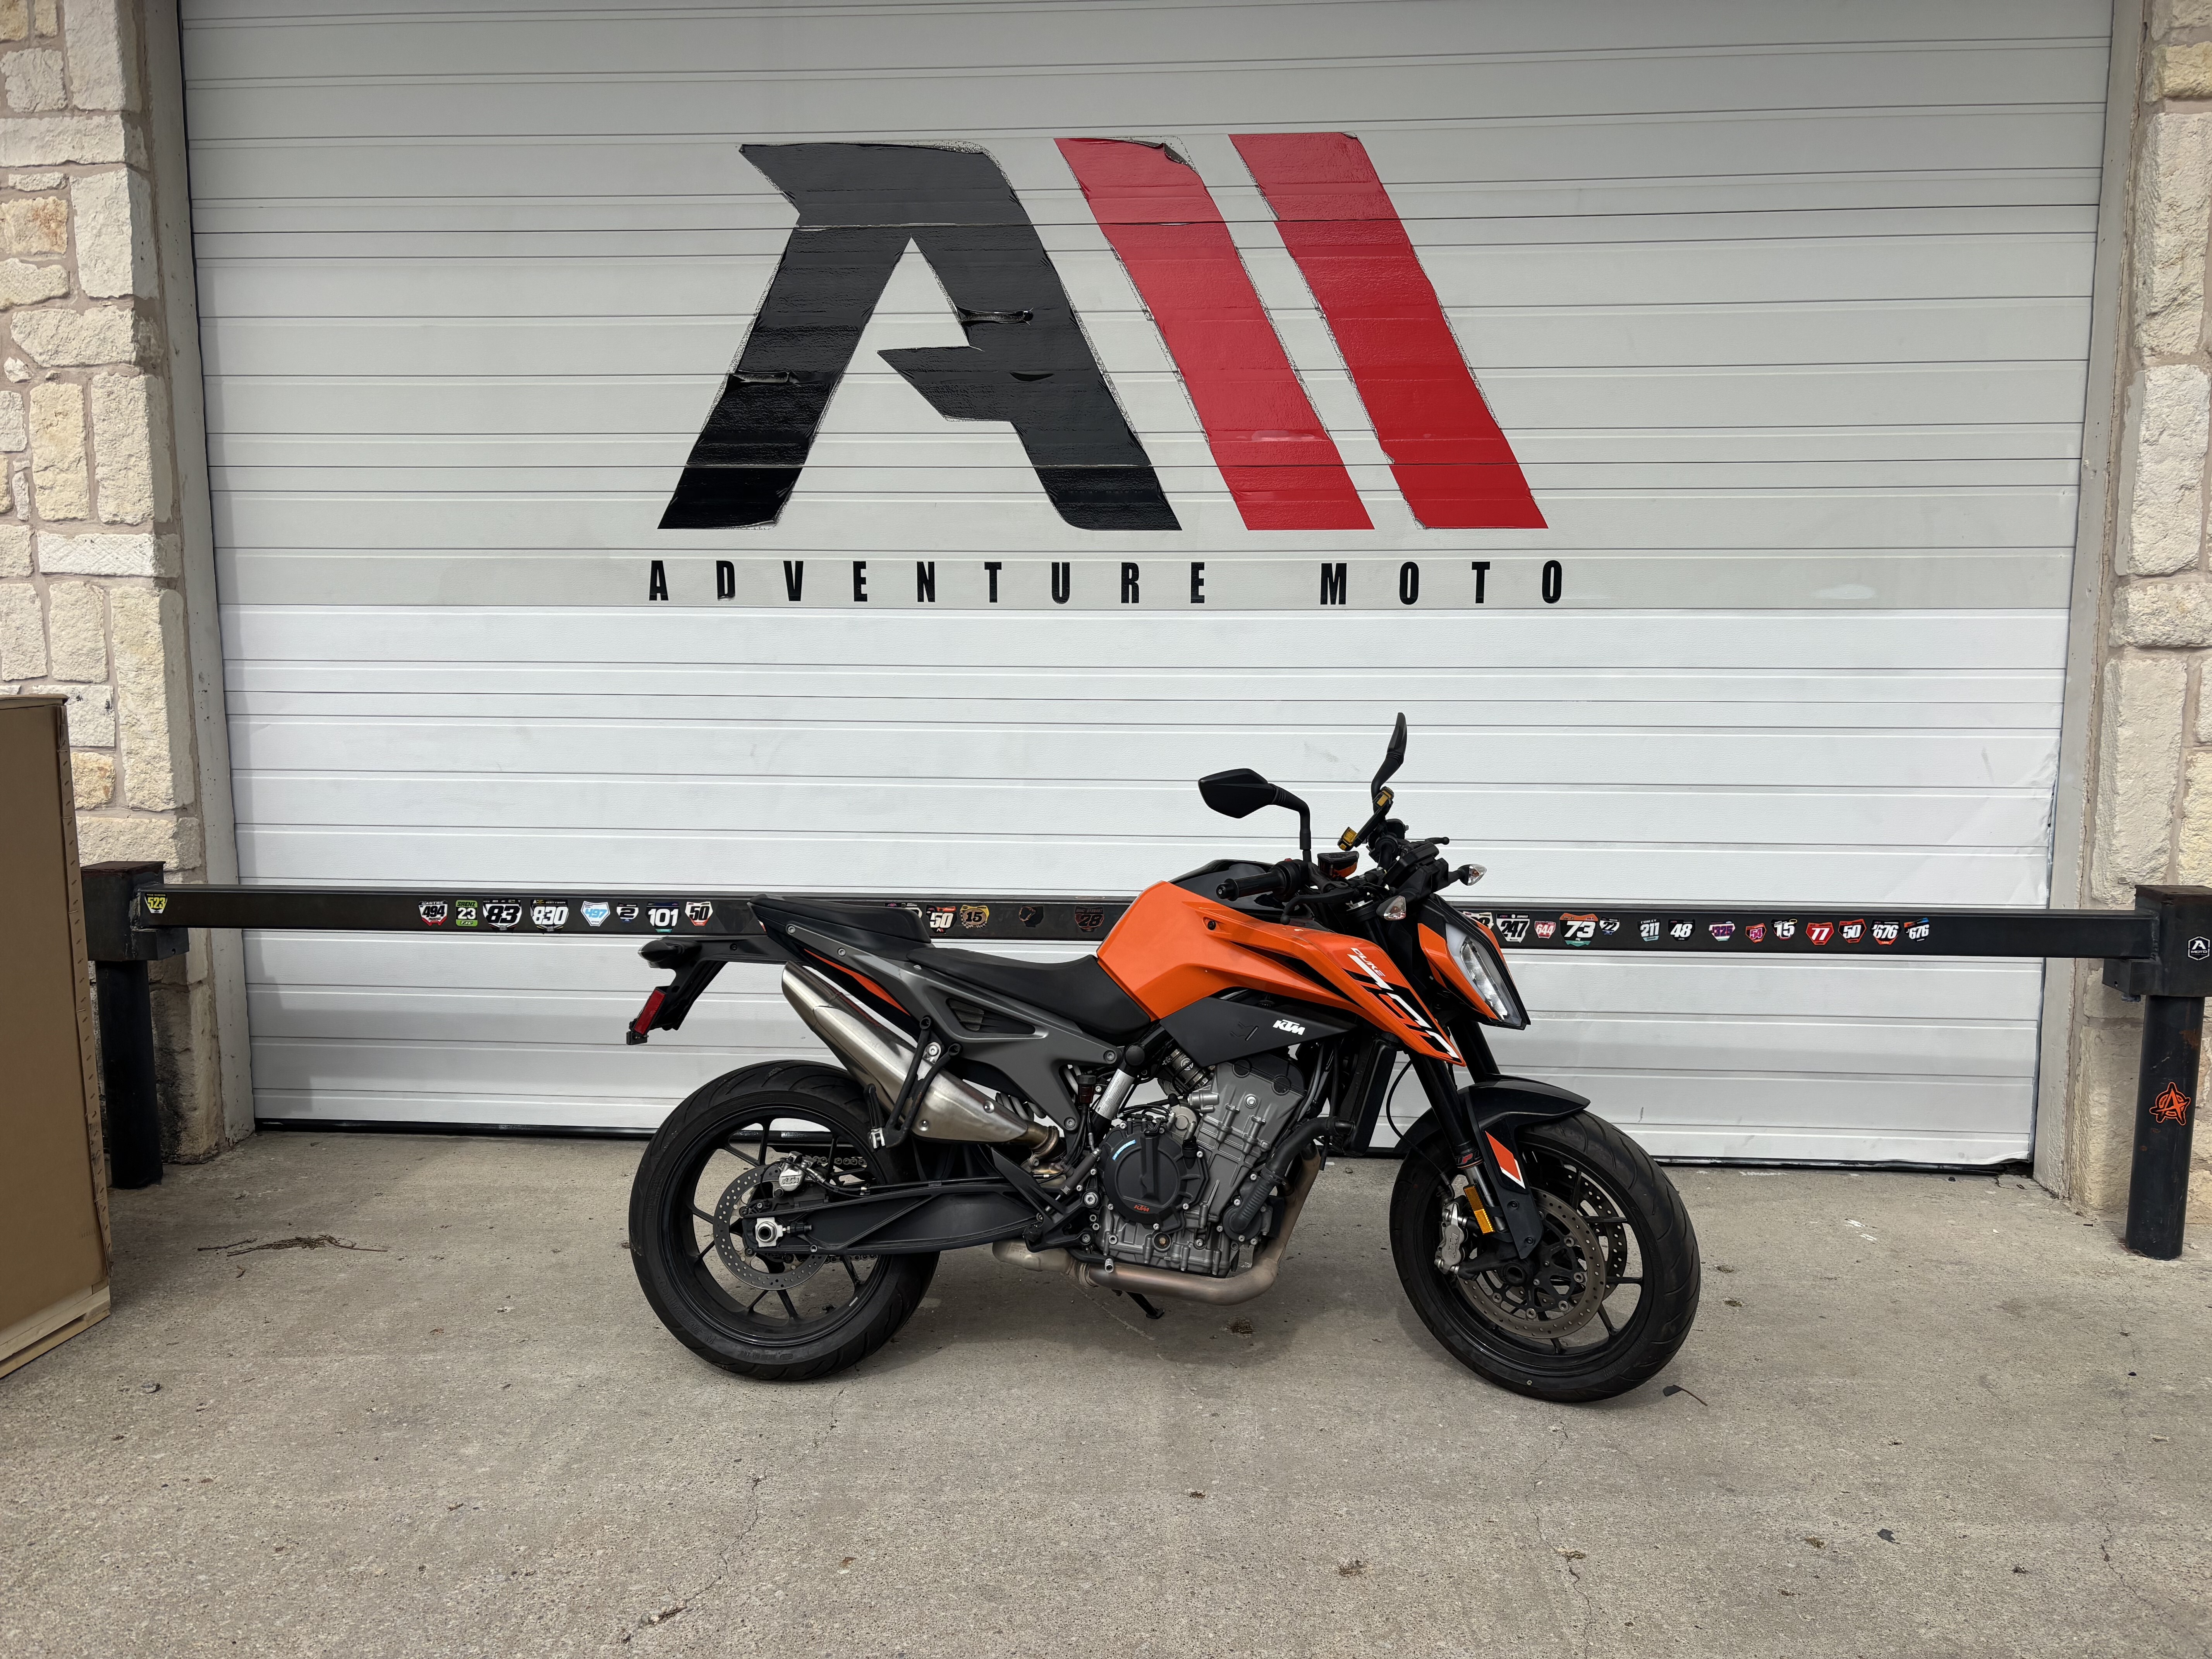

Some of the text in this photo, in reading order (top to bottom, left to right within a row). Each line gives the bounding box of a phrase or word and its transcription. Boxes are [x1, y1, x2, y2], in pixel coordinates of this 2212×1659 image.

[649, 560, 1563, 605] ADVENTURE MOTO
[148, 897, 166, 908] 523
[422, 905, 445, 917] 494
[458, 907, 476, 919] 23
[486, 906, 520, 923] 83
[532, 907, 568, 924] 830
[585, 908, 607, 918] 497
[620, 908, 635, 918] 2
[648, 908, 678, 926] 101
[689, 906, 709, 921] 50
[966, 912, 983, 922] 15
[930, 912, 953, 928] 50
[1078, 914, 1102, 927] 28
[1602, 922, 1617, 931] 22
[1501, 921, 1528, 938] 247
[1536, 924, 1553, 935] 644
[1564, 921, 1595, 938] 73
[1640, 922, 1660, 937] 211
[1670, 924, 1693, 937] 48
[1750, 928, 1762, 939] 54
[1774, 922, 1795, 937] 15
[1812, 928, 1830, 940] 77
[1843, 925, 1861, 938] 50
[1350, 948, 1386, 977] DUKE
[1273, 1019, 1305, 1035] KTM
